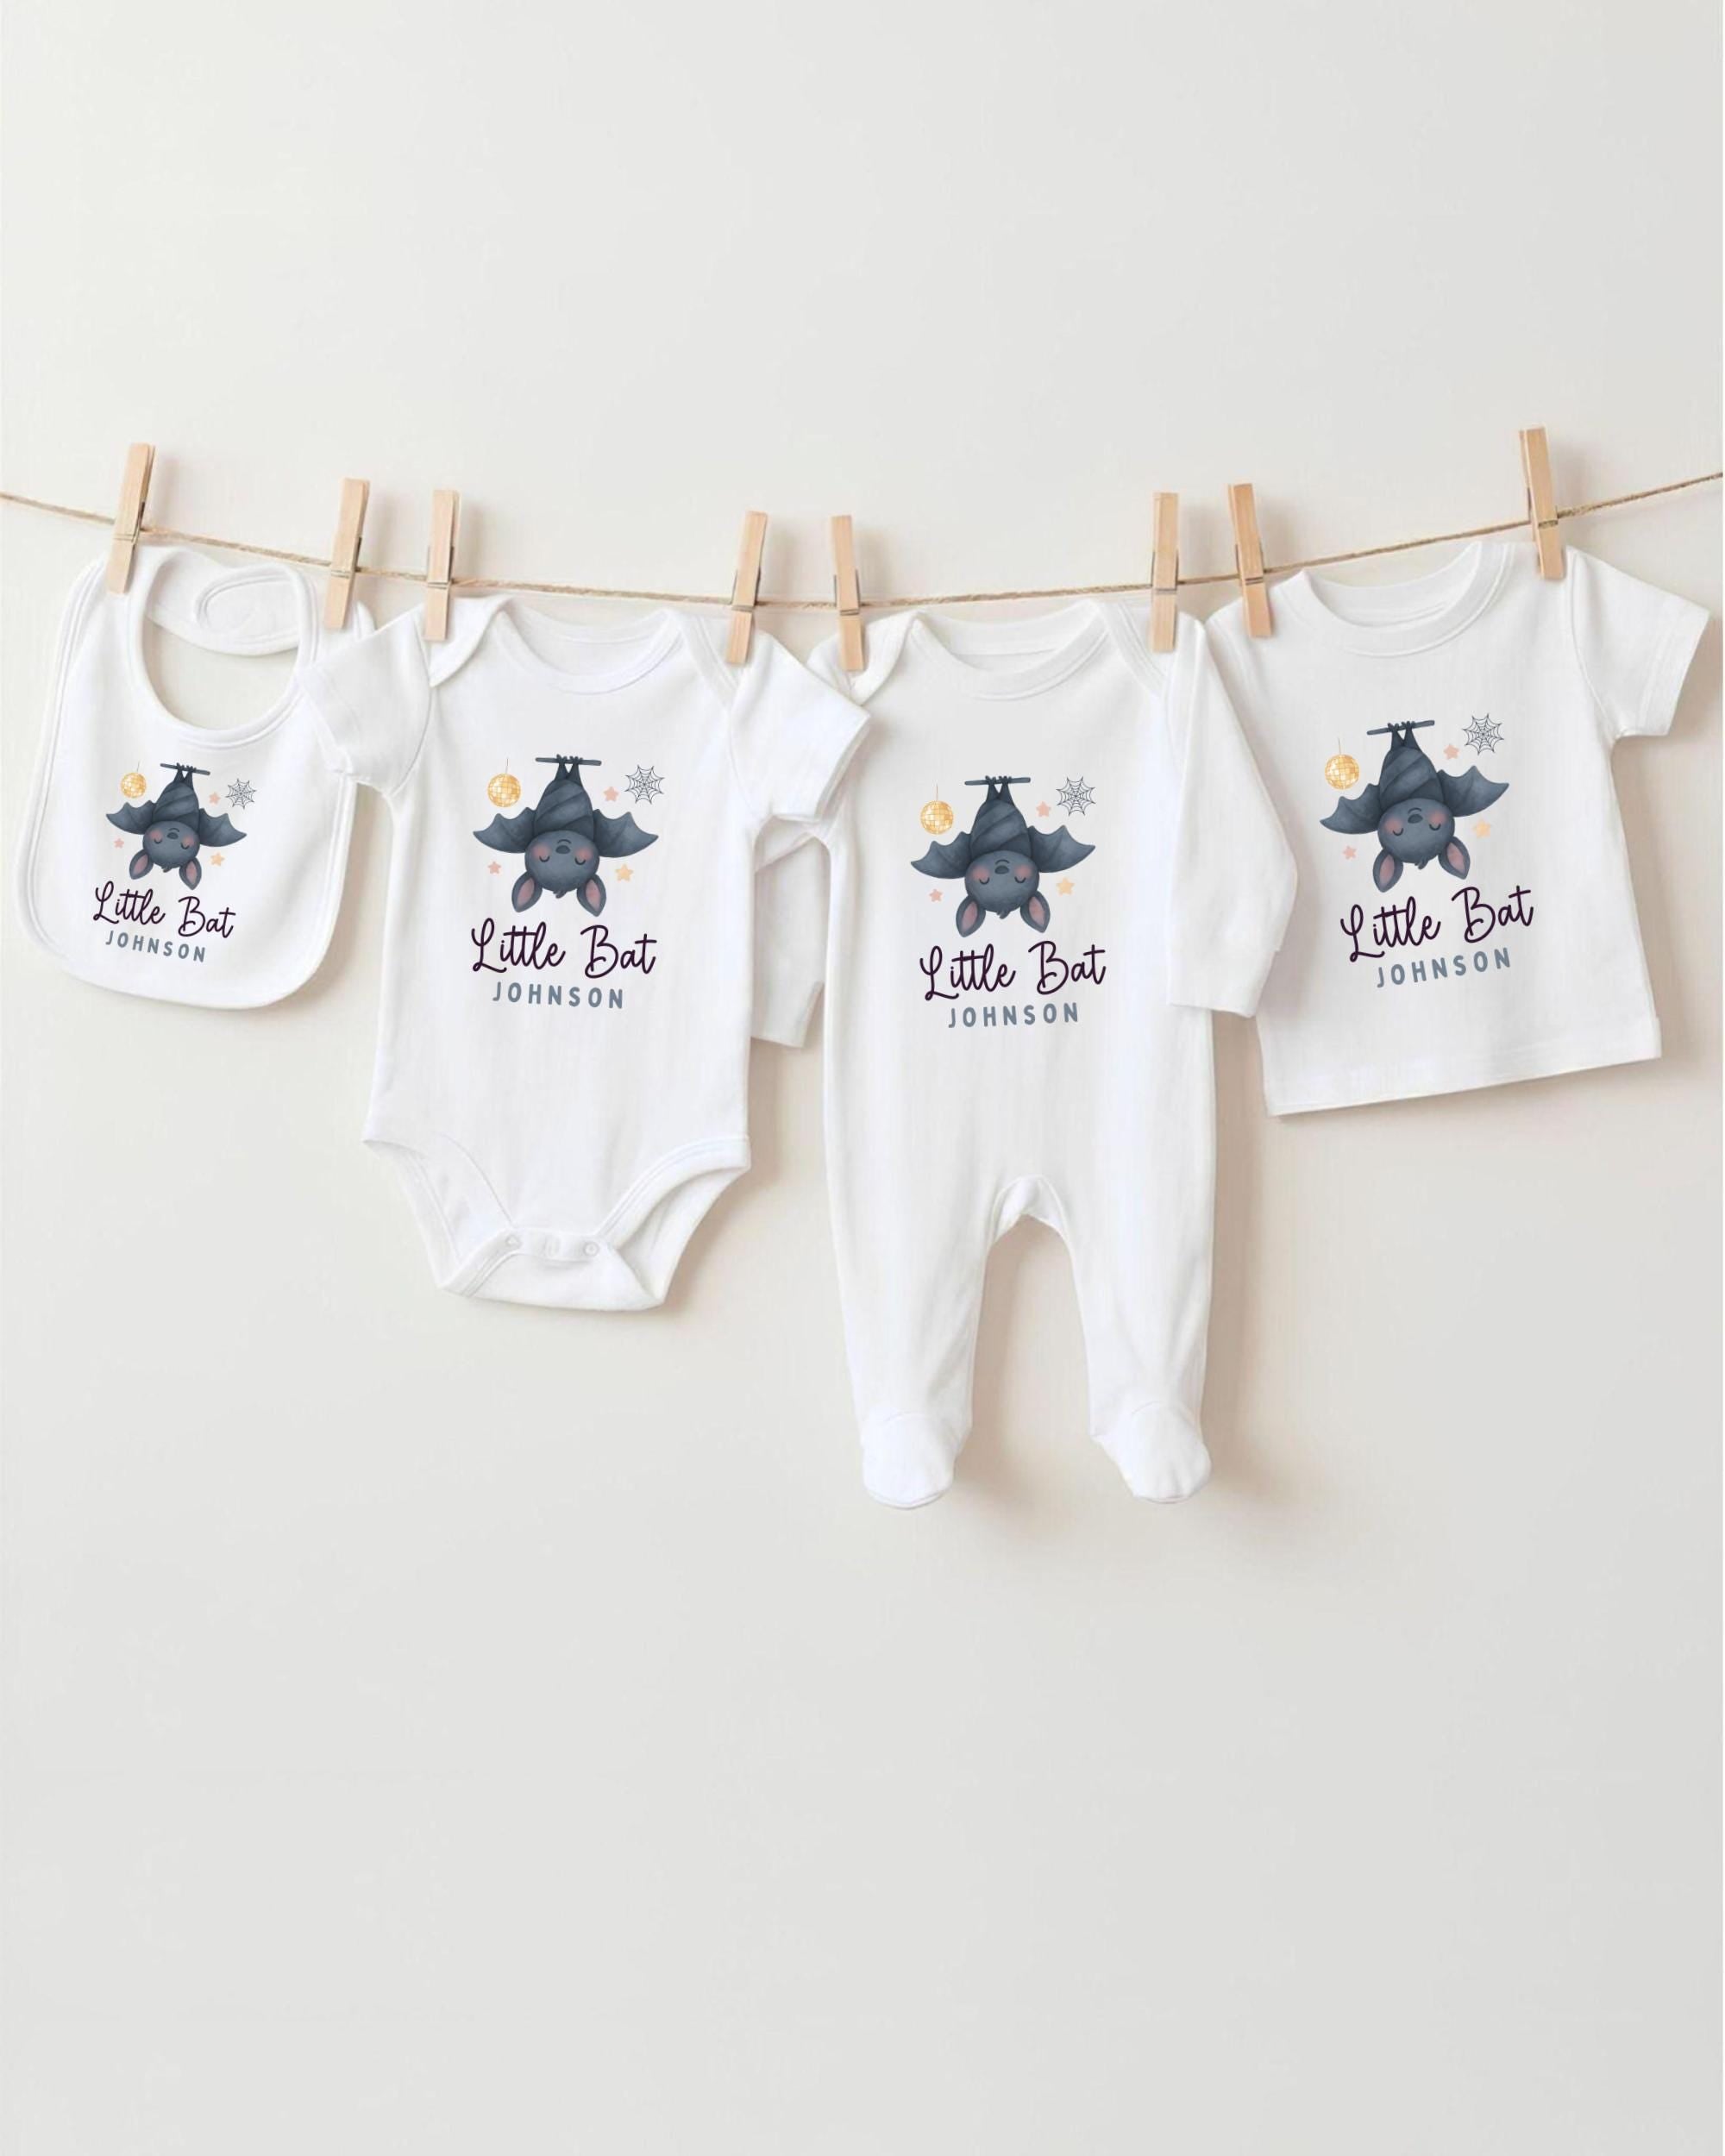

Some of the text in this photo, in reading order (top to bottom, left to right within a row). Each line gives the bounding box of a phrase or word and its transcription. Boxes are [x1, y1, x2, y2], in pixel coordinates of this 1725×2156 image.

[92, 880, 236, 939] Little Bat
[1339, 884, 1534, 963] Little Bat
[105, 930, 205, 962] JOHNSON
[470, 917, 658, 980] Little Bat
[919, 940, 1107, 1002] Little Bat
[1377, 947, 1511, 988] JOHNSON
[492, 981, 623, 1009] JOHNSON
[948, 1002, 1078, 1029] JOHNSON
